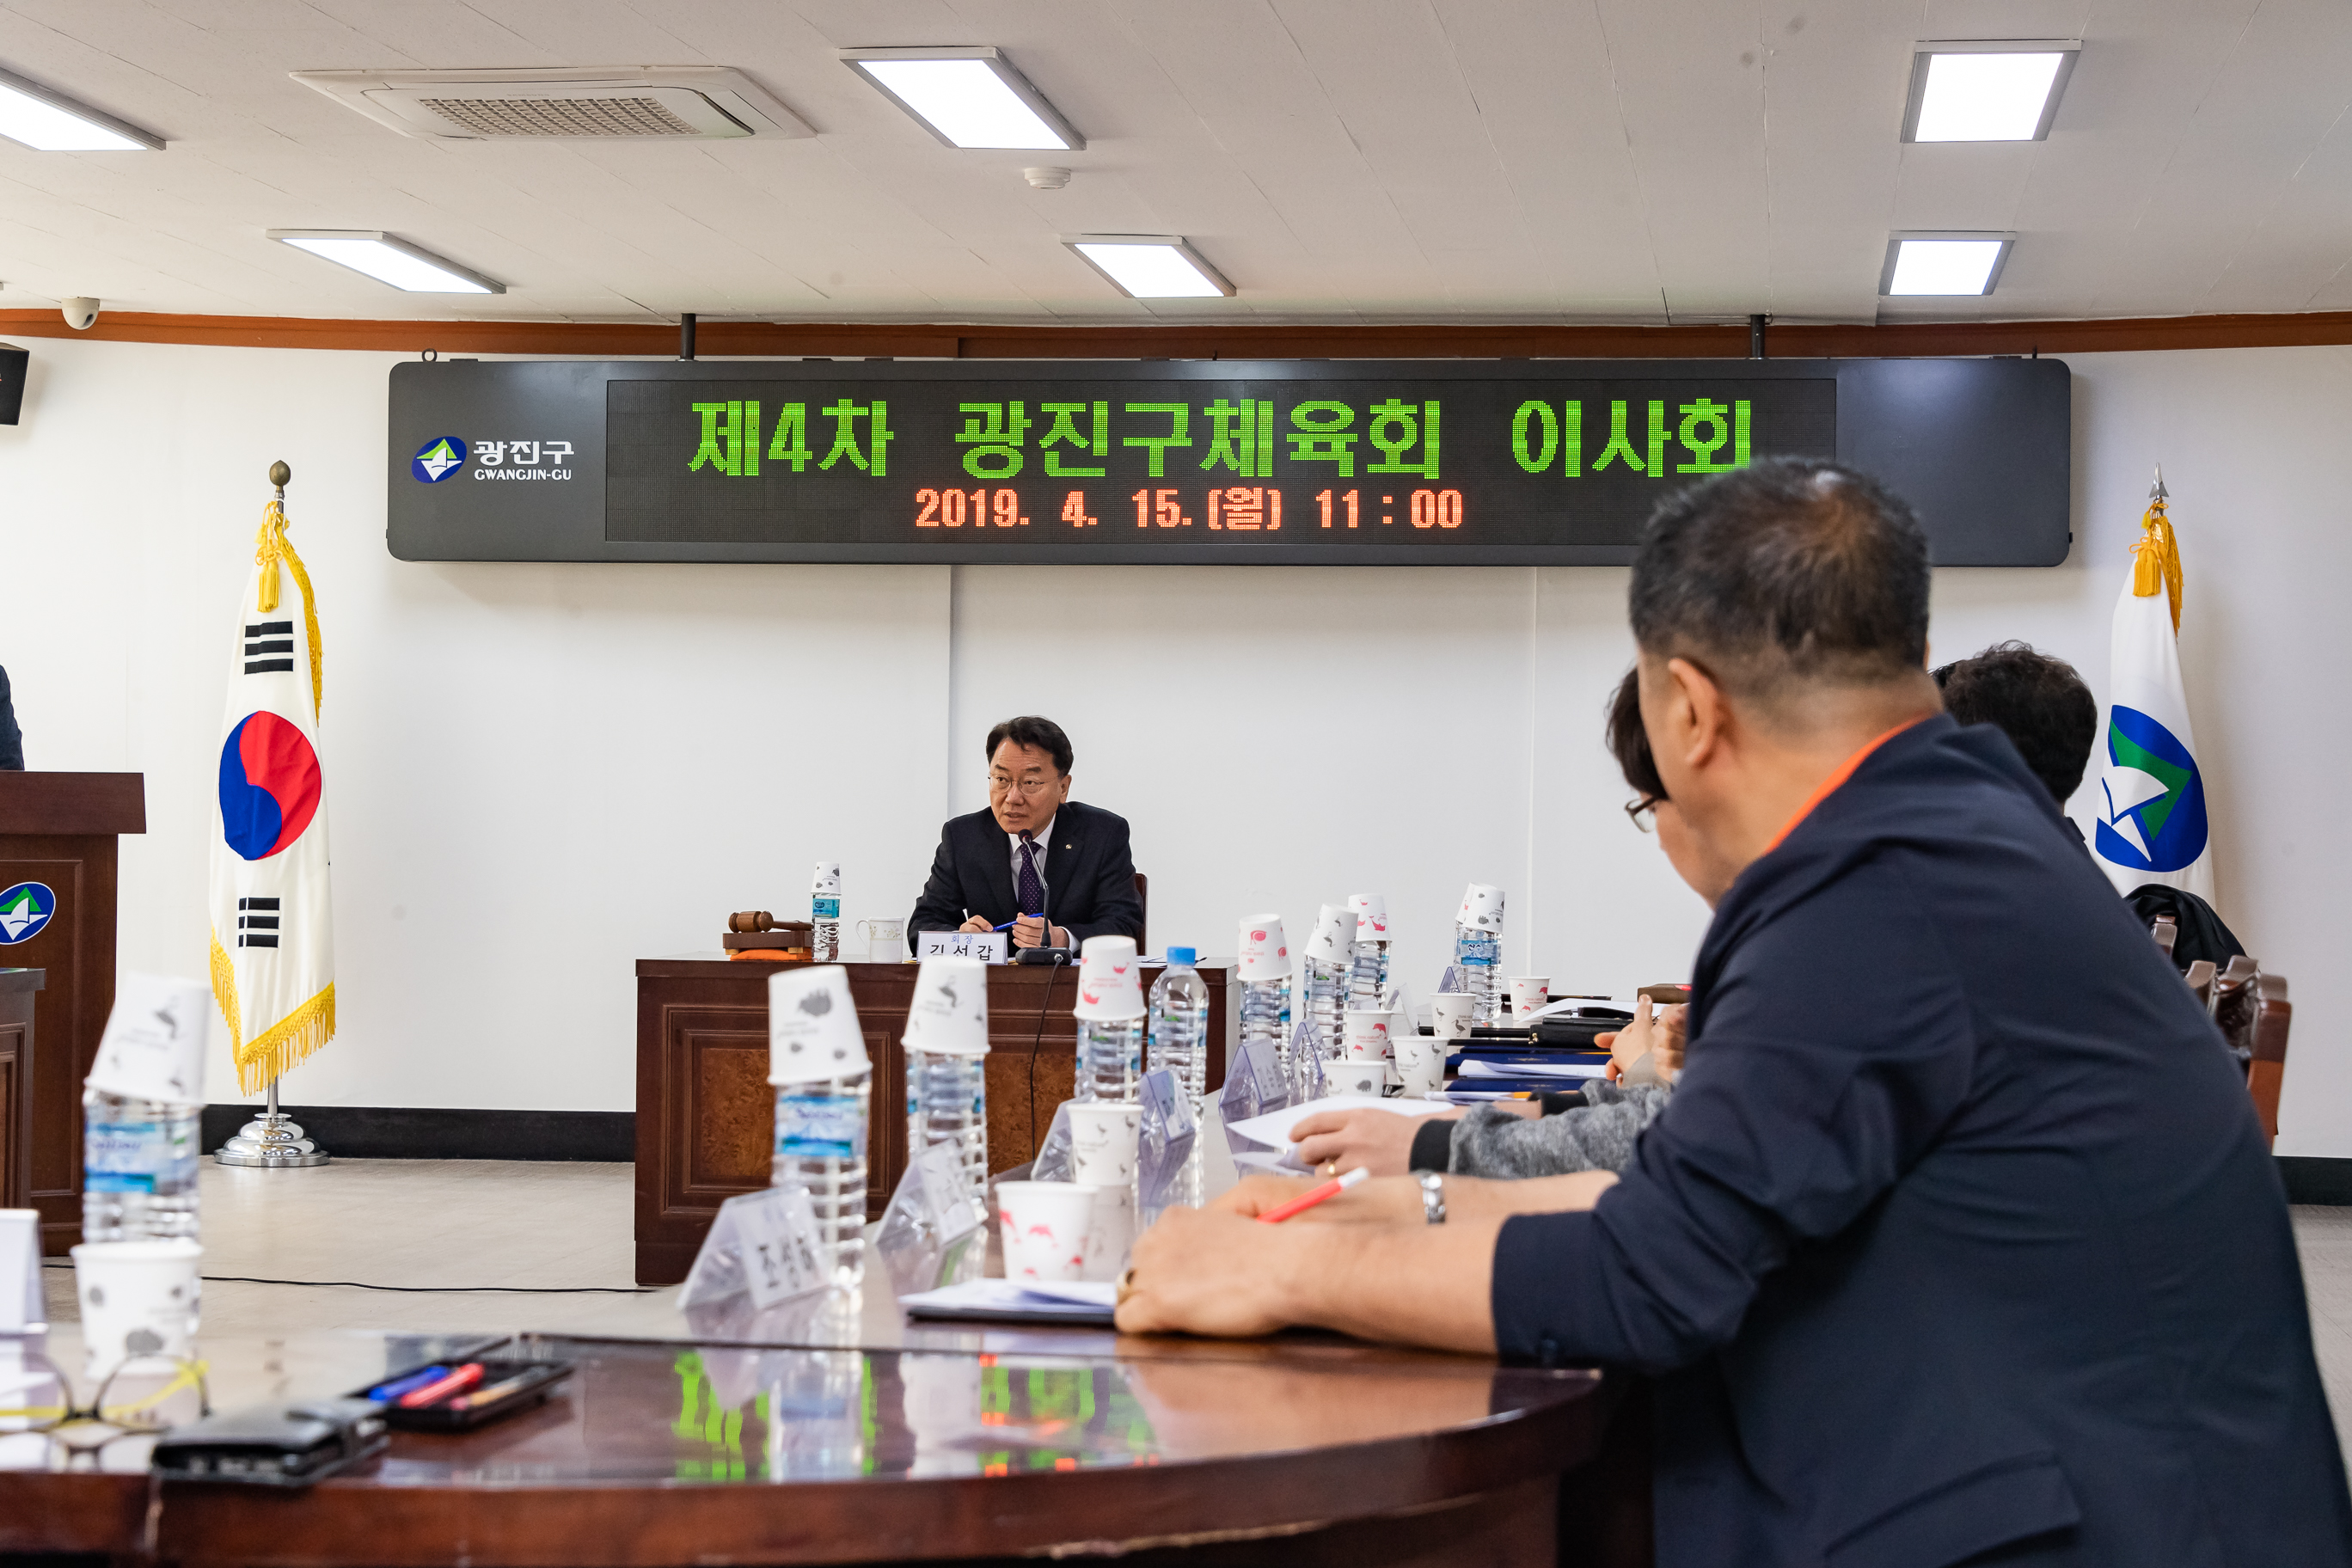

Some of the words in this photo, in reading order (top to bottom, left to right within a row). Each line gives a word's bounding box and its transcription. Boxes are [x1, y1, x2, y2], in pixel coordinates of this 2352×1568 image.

[473, 440, 575, 467] 광진구
[687, 398, 894, 477] 제4차
[954, 398, 1441, 480] 광진구체육회
[1511, 398, 1751, 478] 이사회
[474, 469, 572, 481] GWANGJIN-GU
[915, 487, 1030, 528] 2019.
[1061, 490, 1099, 528] 4.
